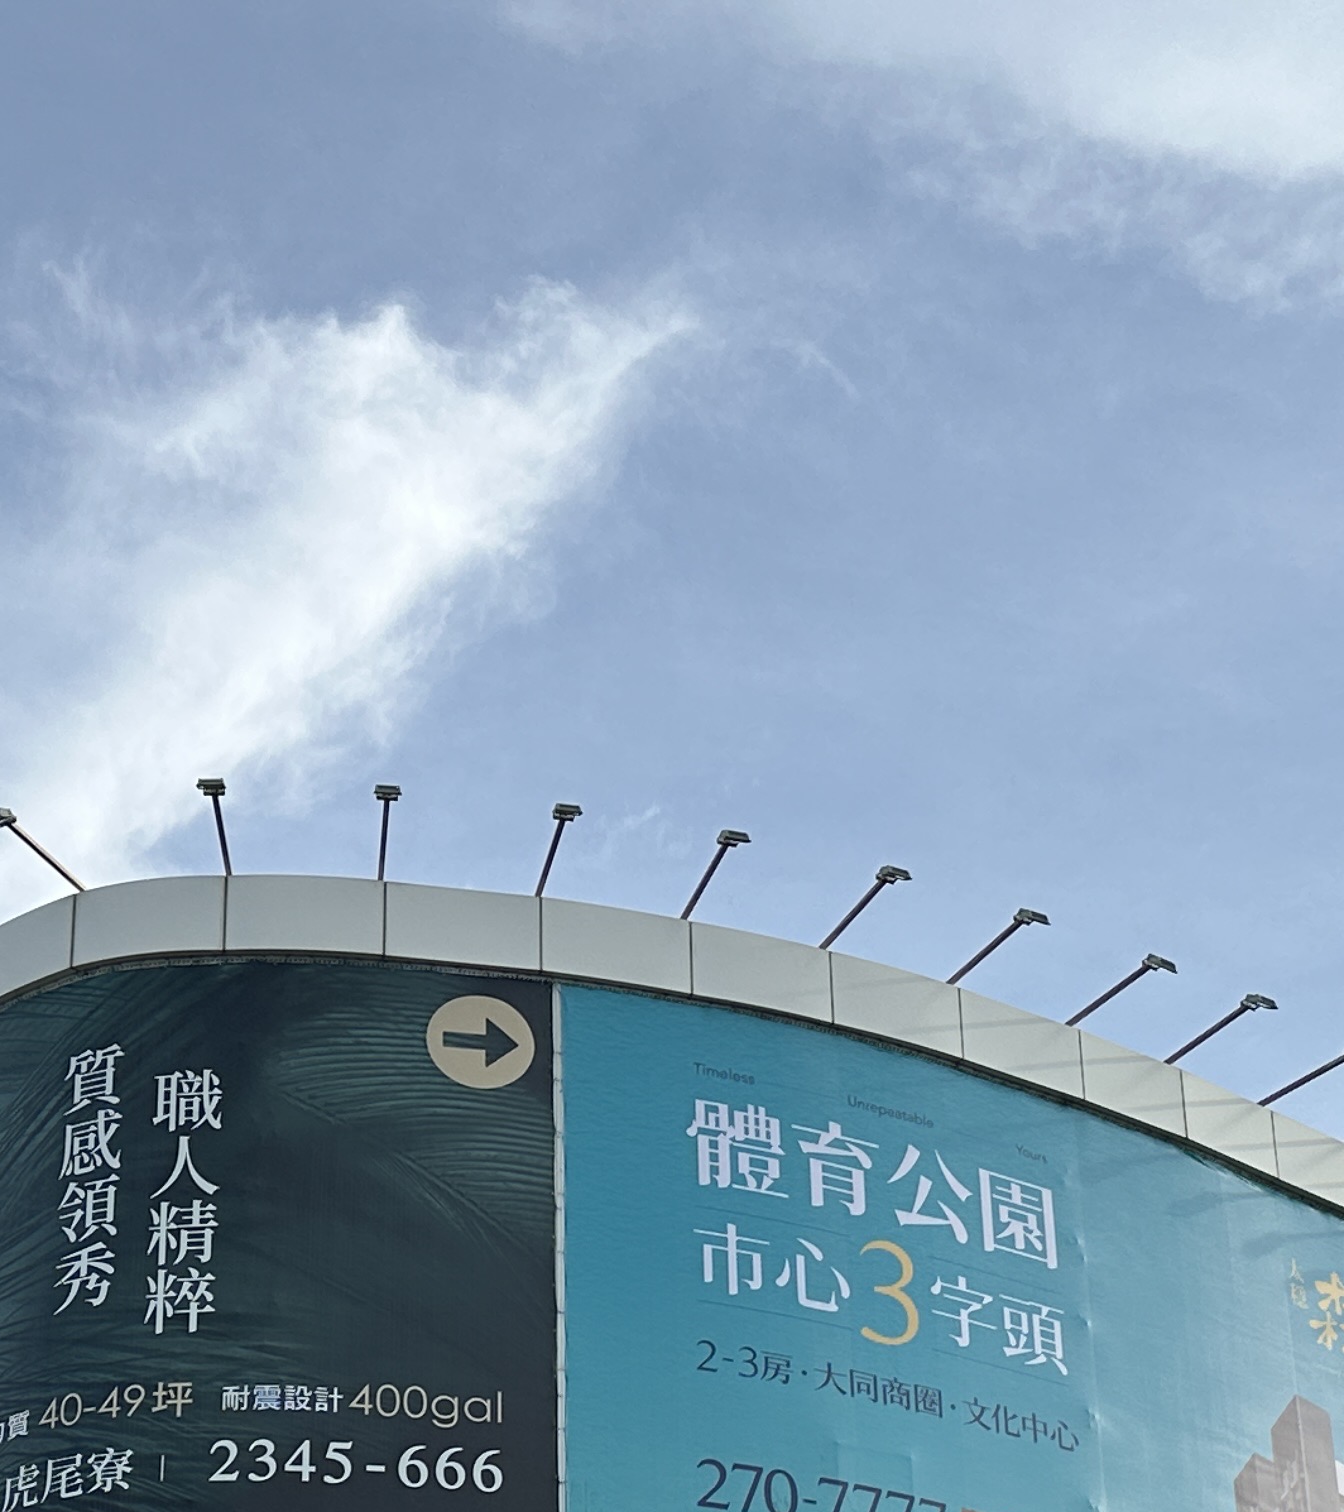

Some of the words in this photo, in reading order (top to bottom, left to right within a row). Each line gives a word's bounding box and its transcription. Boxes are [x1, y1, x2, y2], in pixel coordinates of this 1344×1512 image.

[693, 1061, 756, 1086] Timeless
[52, 1042, 126, 1316] 質感領秀
[142, 1069, 224, 1336] 職人精粹
[686, 1097, 1058, 1269] 體育公園
[693, 1222, 1070, 1377] 市心3字頭
[207, 1438, 505, 1494] 2345-666
[221, 1384, 344, 1415] 耐震設計
[347, 1382, 504, 1430] 400gal
